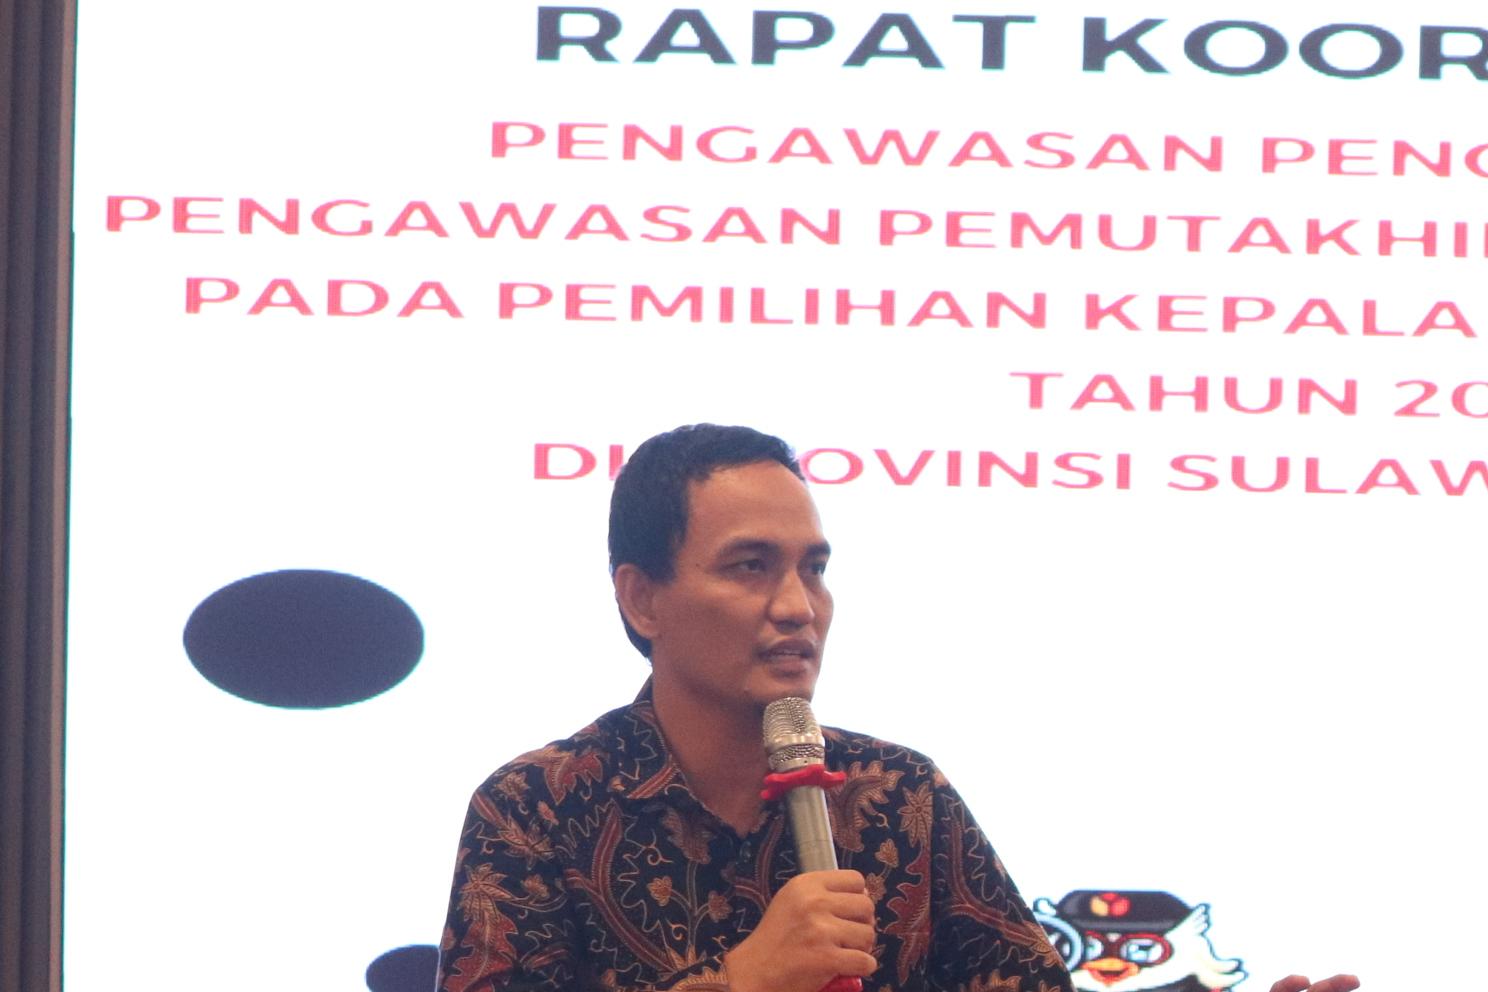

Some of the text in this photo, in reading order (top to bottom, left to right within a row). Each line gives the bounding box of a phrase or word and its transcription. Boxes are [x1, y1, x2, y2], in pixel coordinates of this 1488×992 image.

[536, 5, 1035, 70] RAPAT
[491, 121, 1224, 173] PENGAWASAN
[106, 195, 842, 246] PENGAWASAN
[185, 277, 464, 319] PADA
[498, 282, 1047, 329] PEMILIHAN
[1085, 293, 1477, 339] KEPALA
[1010, 372, 1358, 417] TAHUN
[533, 443, 624, 481] DI
[800, 448, 1131, 490] OVINSI
